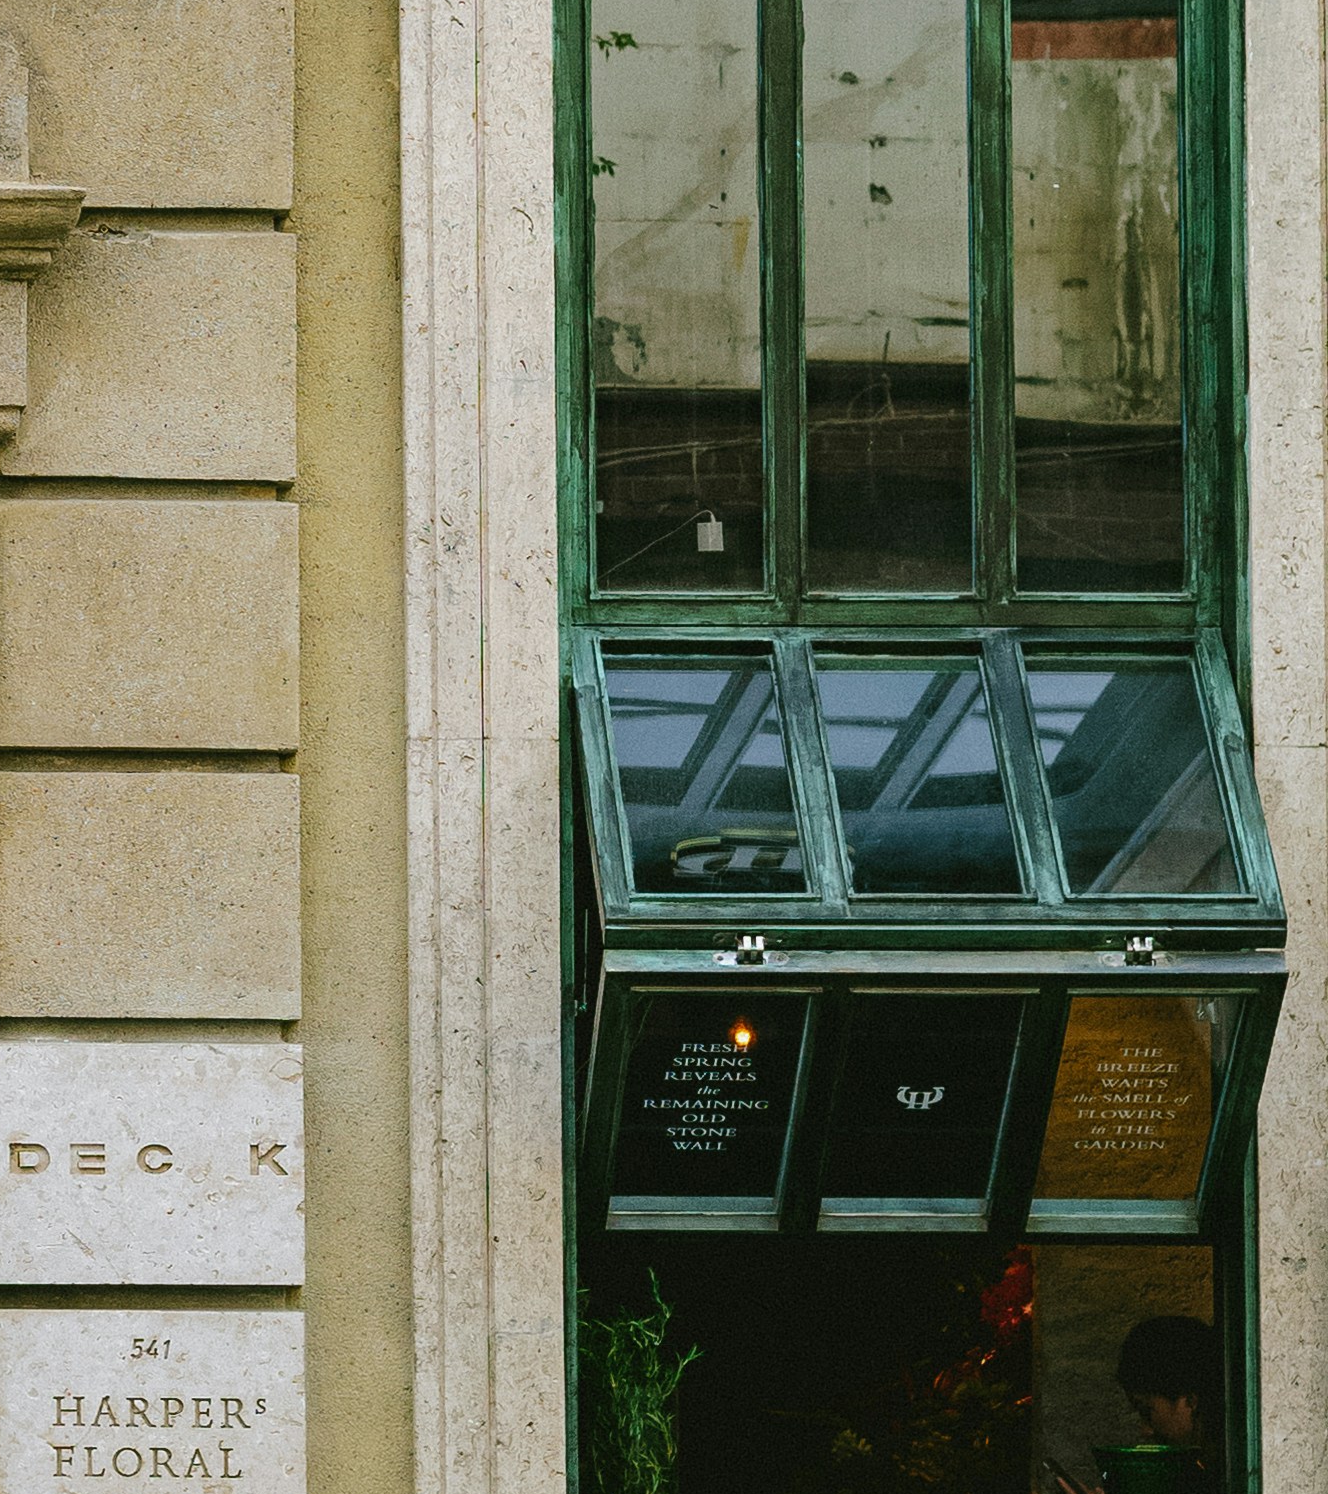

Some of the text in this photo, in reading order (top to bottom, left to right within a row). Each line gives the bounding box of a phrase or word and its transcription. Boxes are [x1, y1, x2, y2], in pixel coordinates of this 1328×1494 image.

[1120, 1048, 1163, 1057] THE
[672, 1057, 752, 1067] SPRING
[1096, 1063, 1180, 1073] BREEZE
[664, 1071, 757, 1081] REVEALS
[1101, 1078, 1169, 1088] WAFTS
[697, 1085, 721, 1095] the
[643, 1099, 769, 1110] REMAINING
[1102, 1093, 1168, 1104] SMELL
[1173, 1094, 1193, 1107] of
[682, 1113, 726, 1123] OLD
[1077, 1109, 1177, 1120] FLOWERS
[666, 1127, 737, 1137] STONE
[1091, 1125, 1156, 1135] in THE
[672, 1141, 727, 1151] WALL
[1074, 1140, 1166, 1150] GARDEN
[130, 1338, 171, 1359] 541
[53, 1445, 243, 1478] FLORAL
